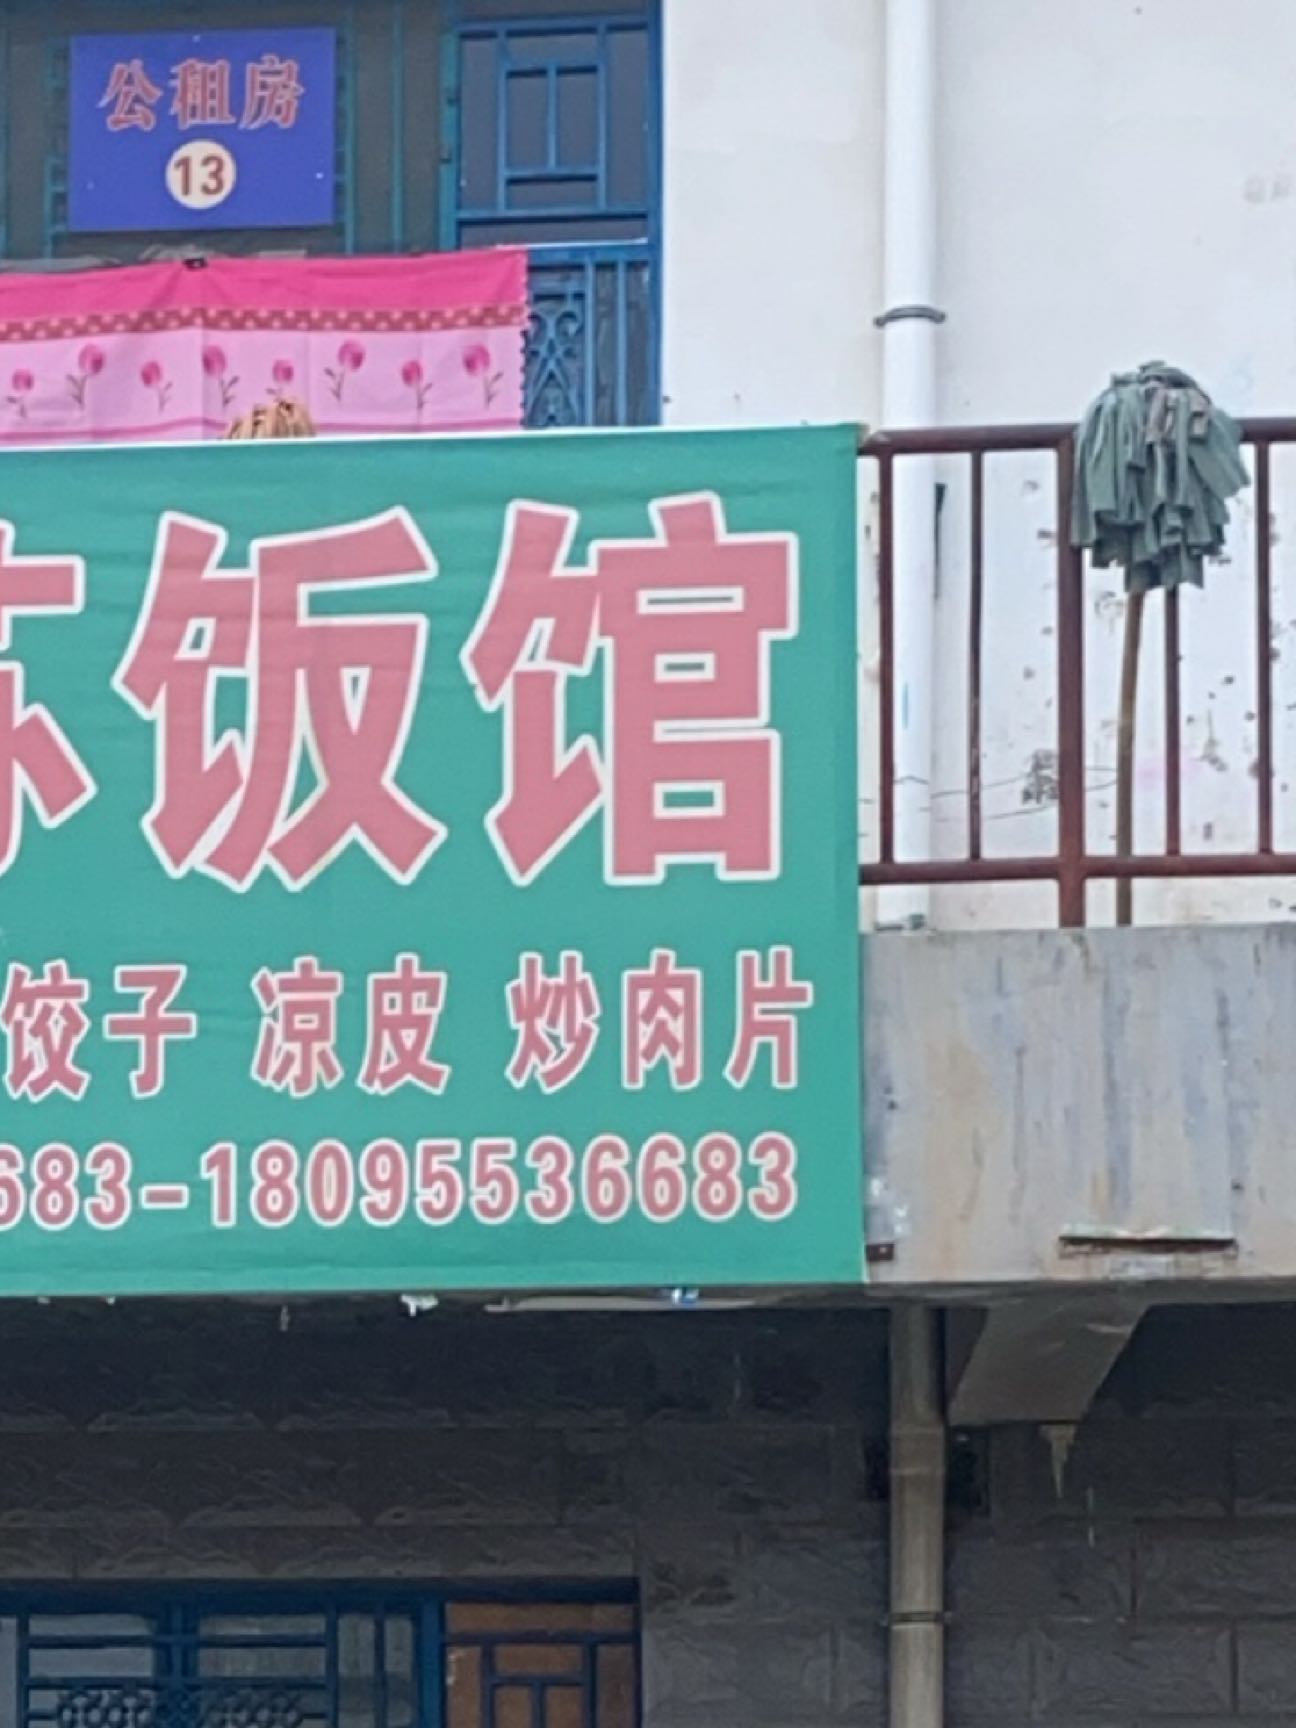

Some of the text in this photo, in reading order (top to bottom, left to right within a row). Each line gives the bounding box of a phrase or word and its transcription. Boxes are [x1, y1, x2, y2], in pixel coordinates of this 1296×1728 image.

[96, 55, 304, 130] 公租房
[173, 155, 226, 197] 13
[0, 963, 192, 1097] 饺子
[255, 956, 446, 1094] 凉皮
[509, 948, 810, 1090] 炒肉片
